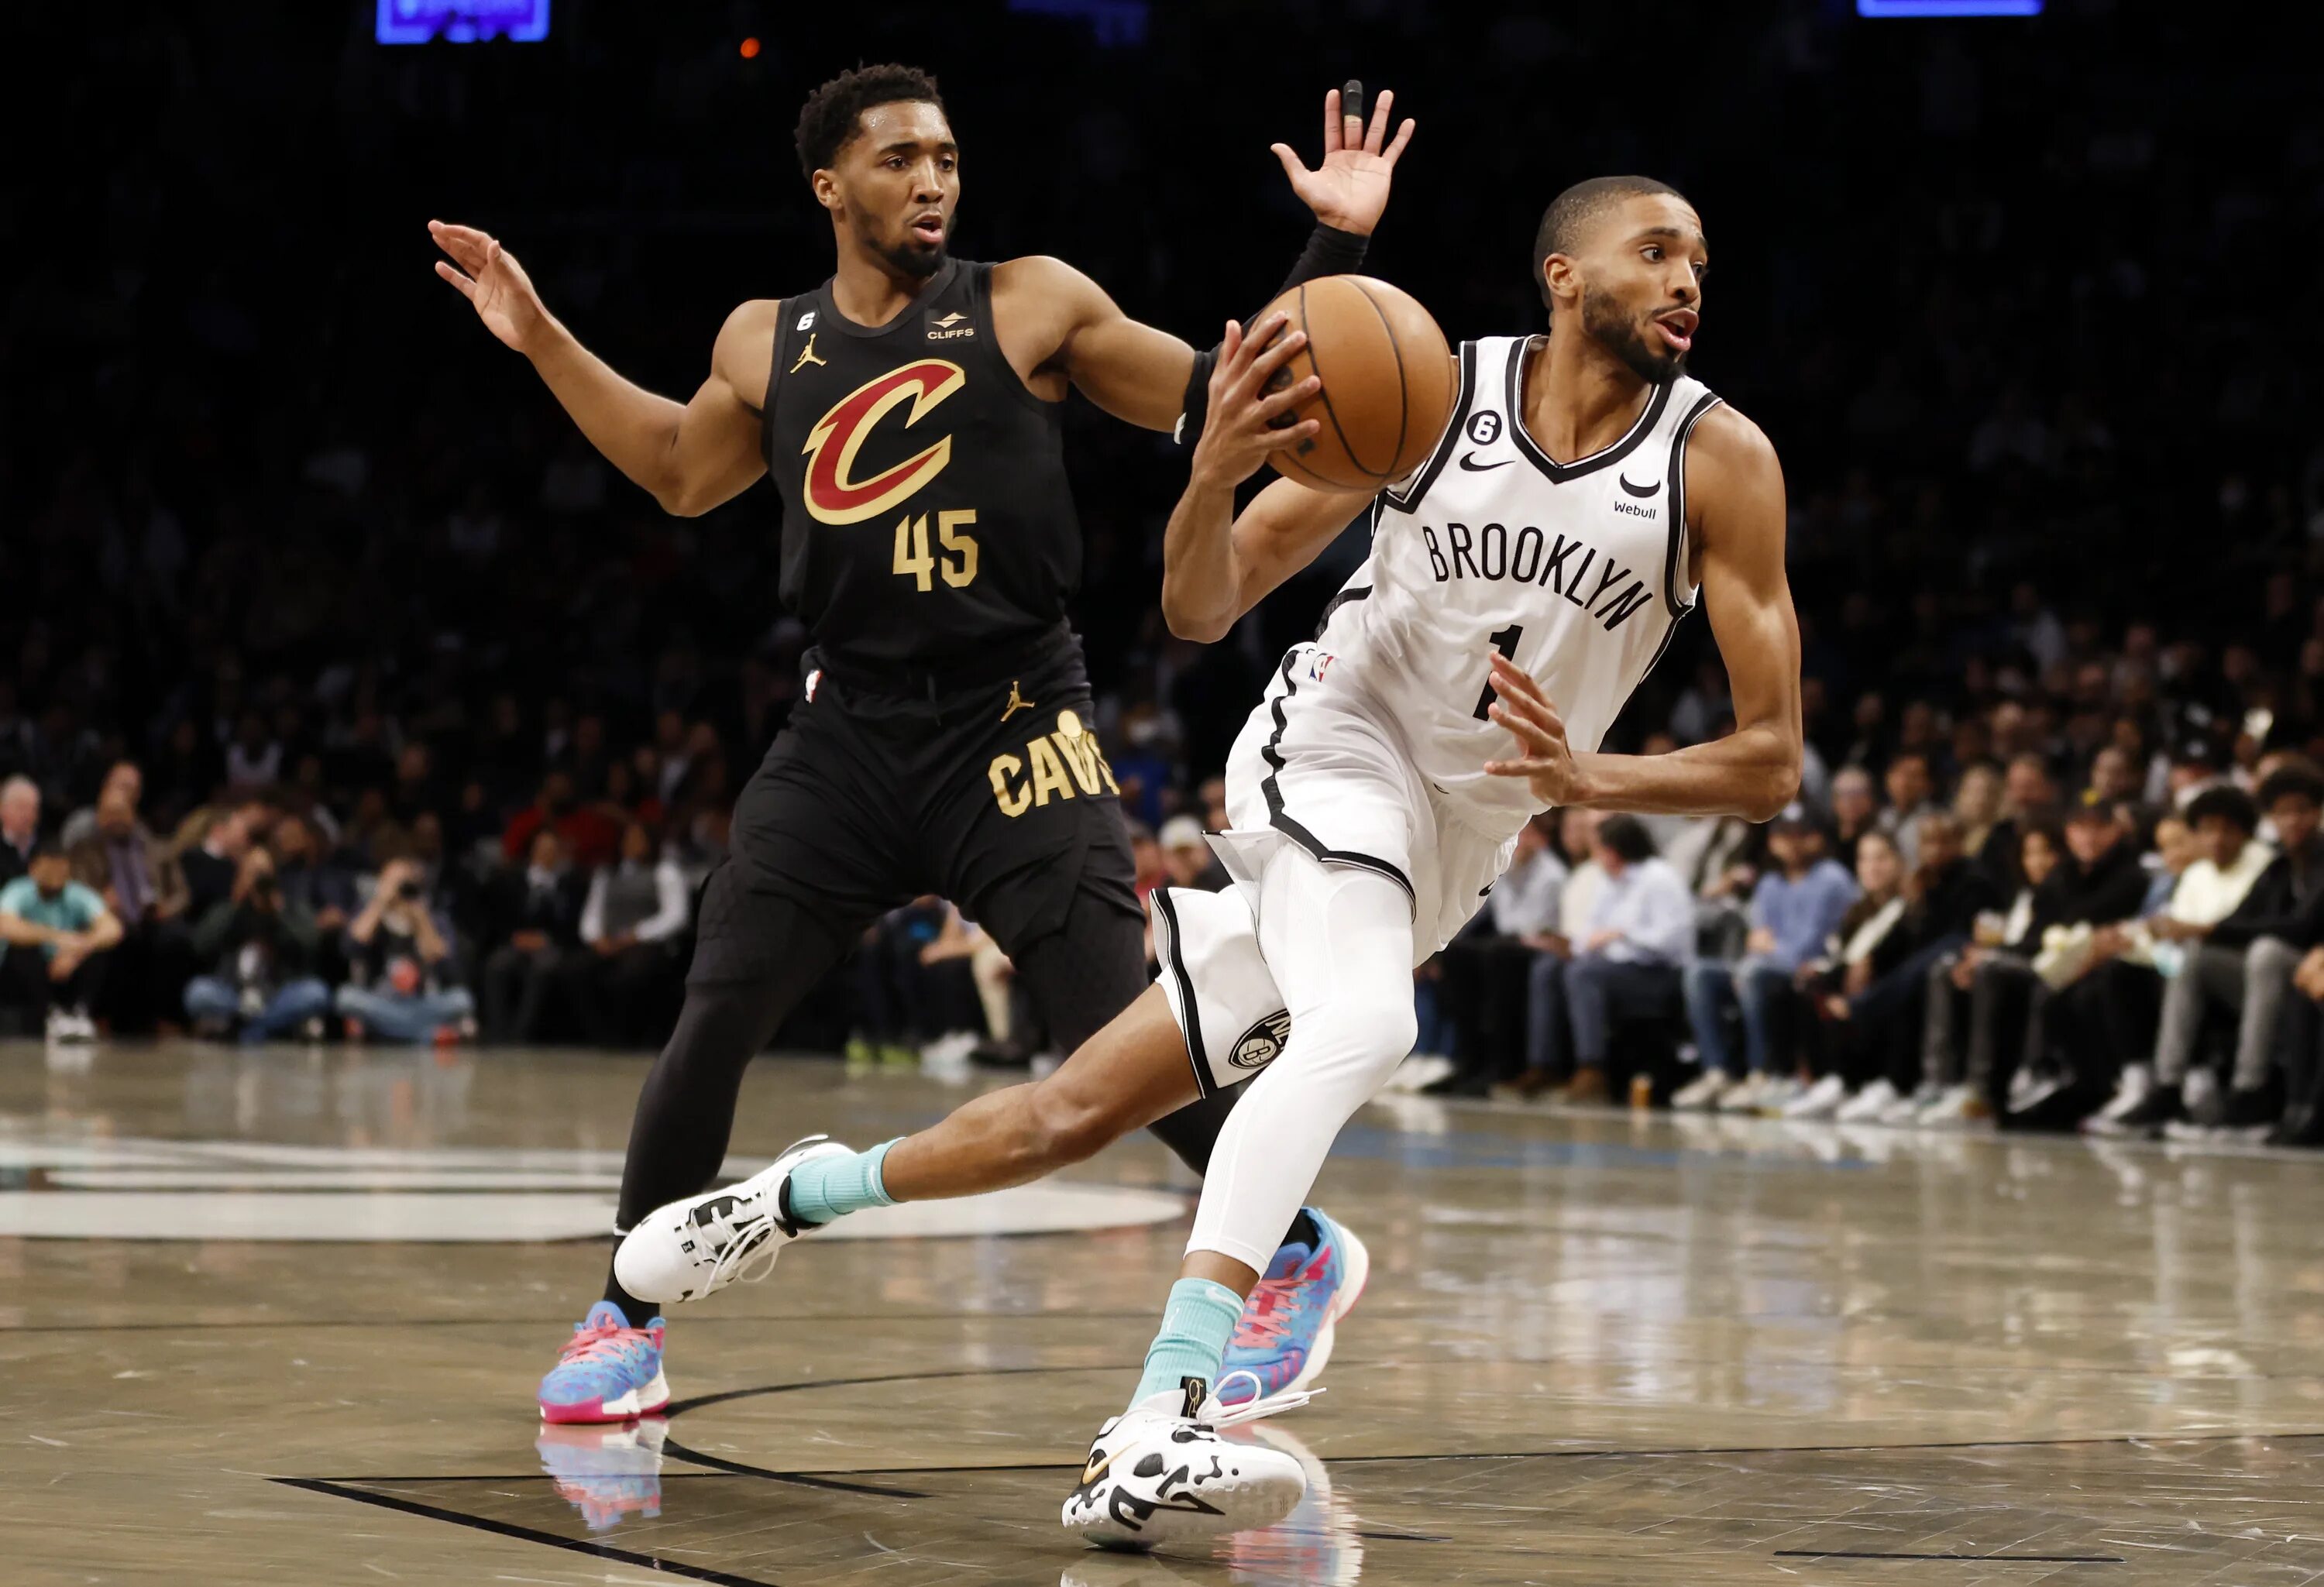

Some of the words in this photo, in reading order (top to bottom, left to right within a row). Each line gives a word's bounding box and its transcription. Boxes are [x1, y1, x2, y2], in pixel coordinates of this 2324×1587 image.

[796, 312, 815, 331] 6
[927, 328, 975, 340] CLIFFS
[802, 359, 965, 525] C
[1473, 414, 1496, 442] 6
[1614, 501, 1656, 520] Webull
[893, 510, 978, 592] 45
[1422, 523, 1652, 631] BROOKLYN
[1472, 624, 1523, 722] 1
